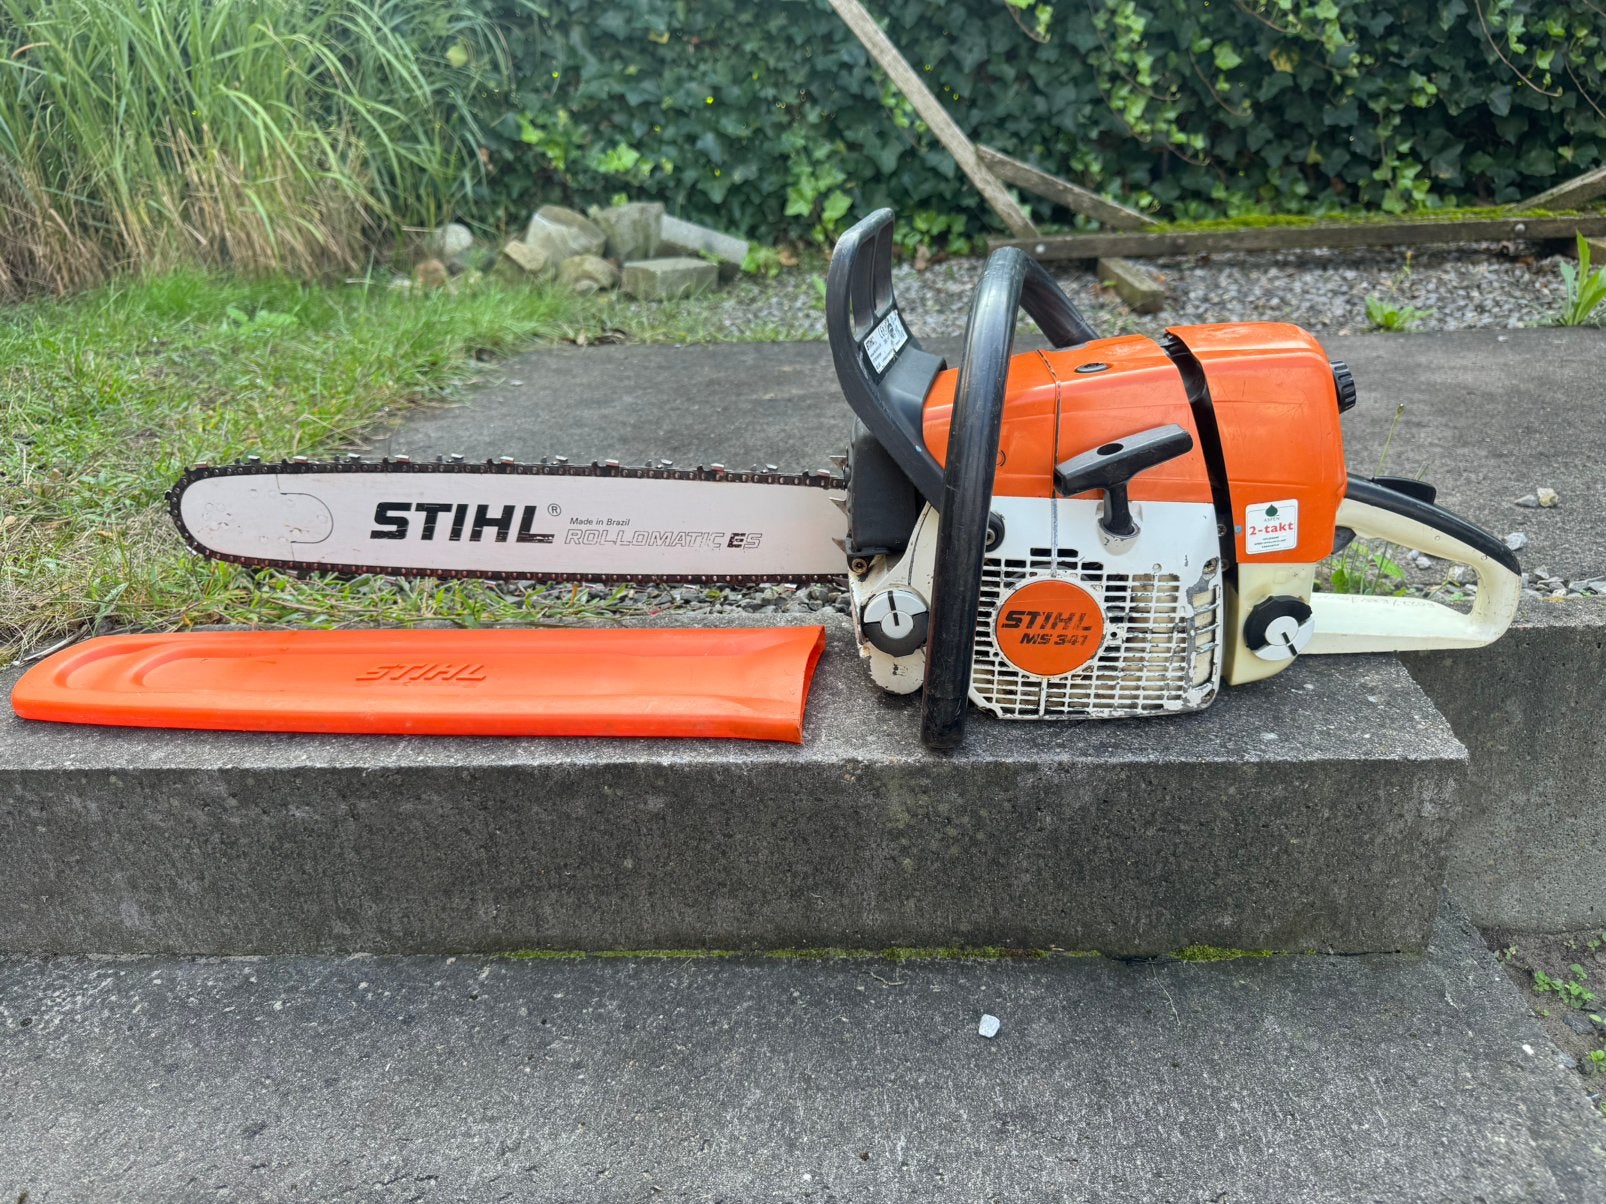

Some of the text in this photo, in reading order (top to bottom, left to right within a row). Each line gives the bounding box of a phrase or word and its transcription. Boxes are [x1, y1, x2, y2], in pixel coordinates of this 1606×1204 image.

[370, 502, 555, 544] STIHL
[569, 517, 630, 526] Made in Brazil
[1249, 522, 1294, 536] 2-takt
[564, 529, 763, 550] ROLLOMATIC ES
[1001, 610, 1093, 632] STIHL
[1020, 632, 1053, 646] MS
[355, 663, 487, 682] STIHL
